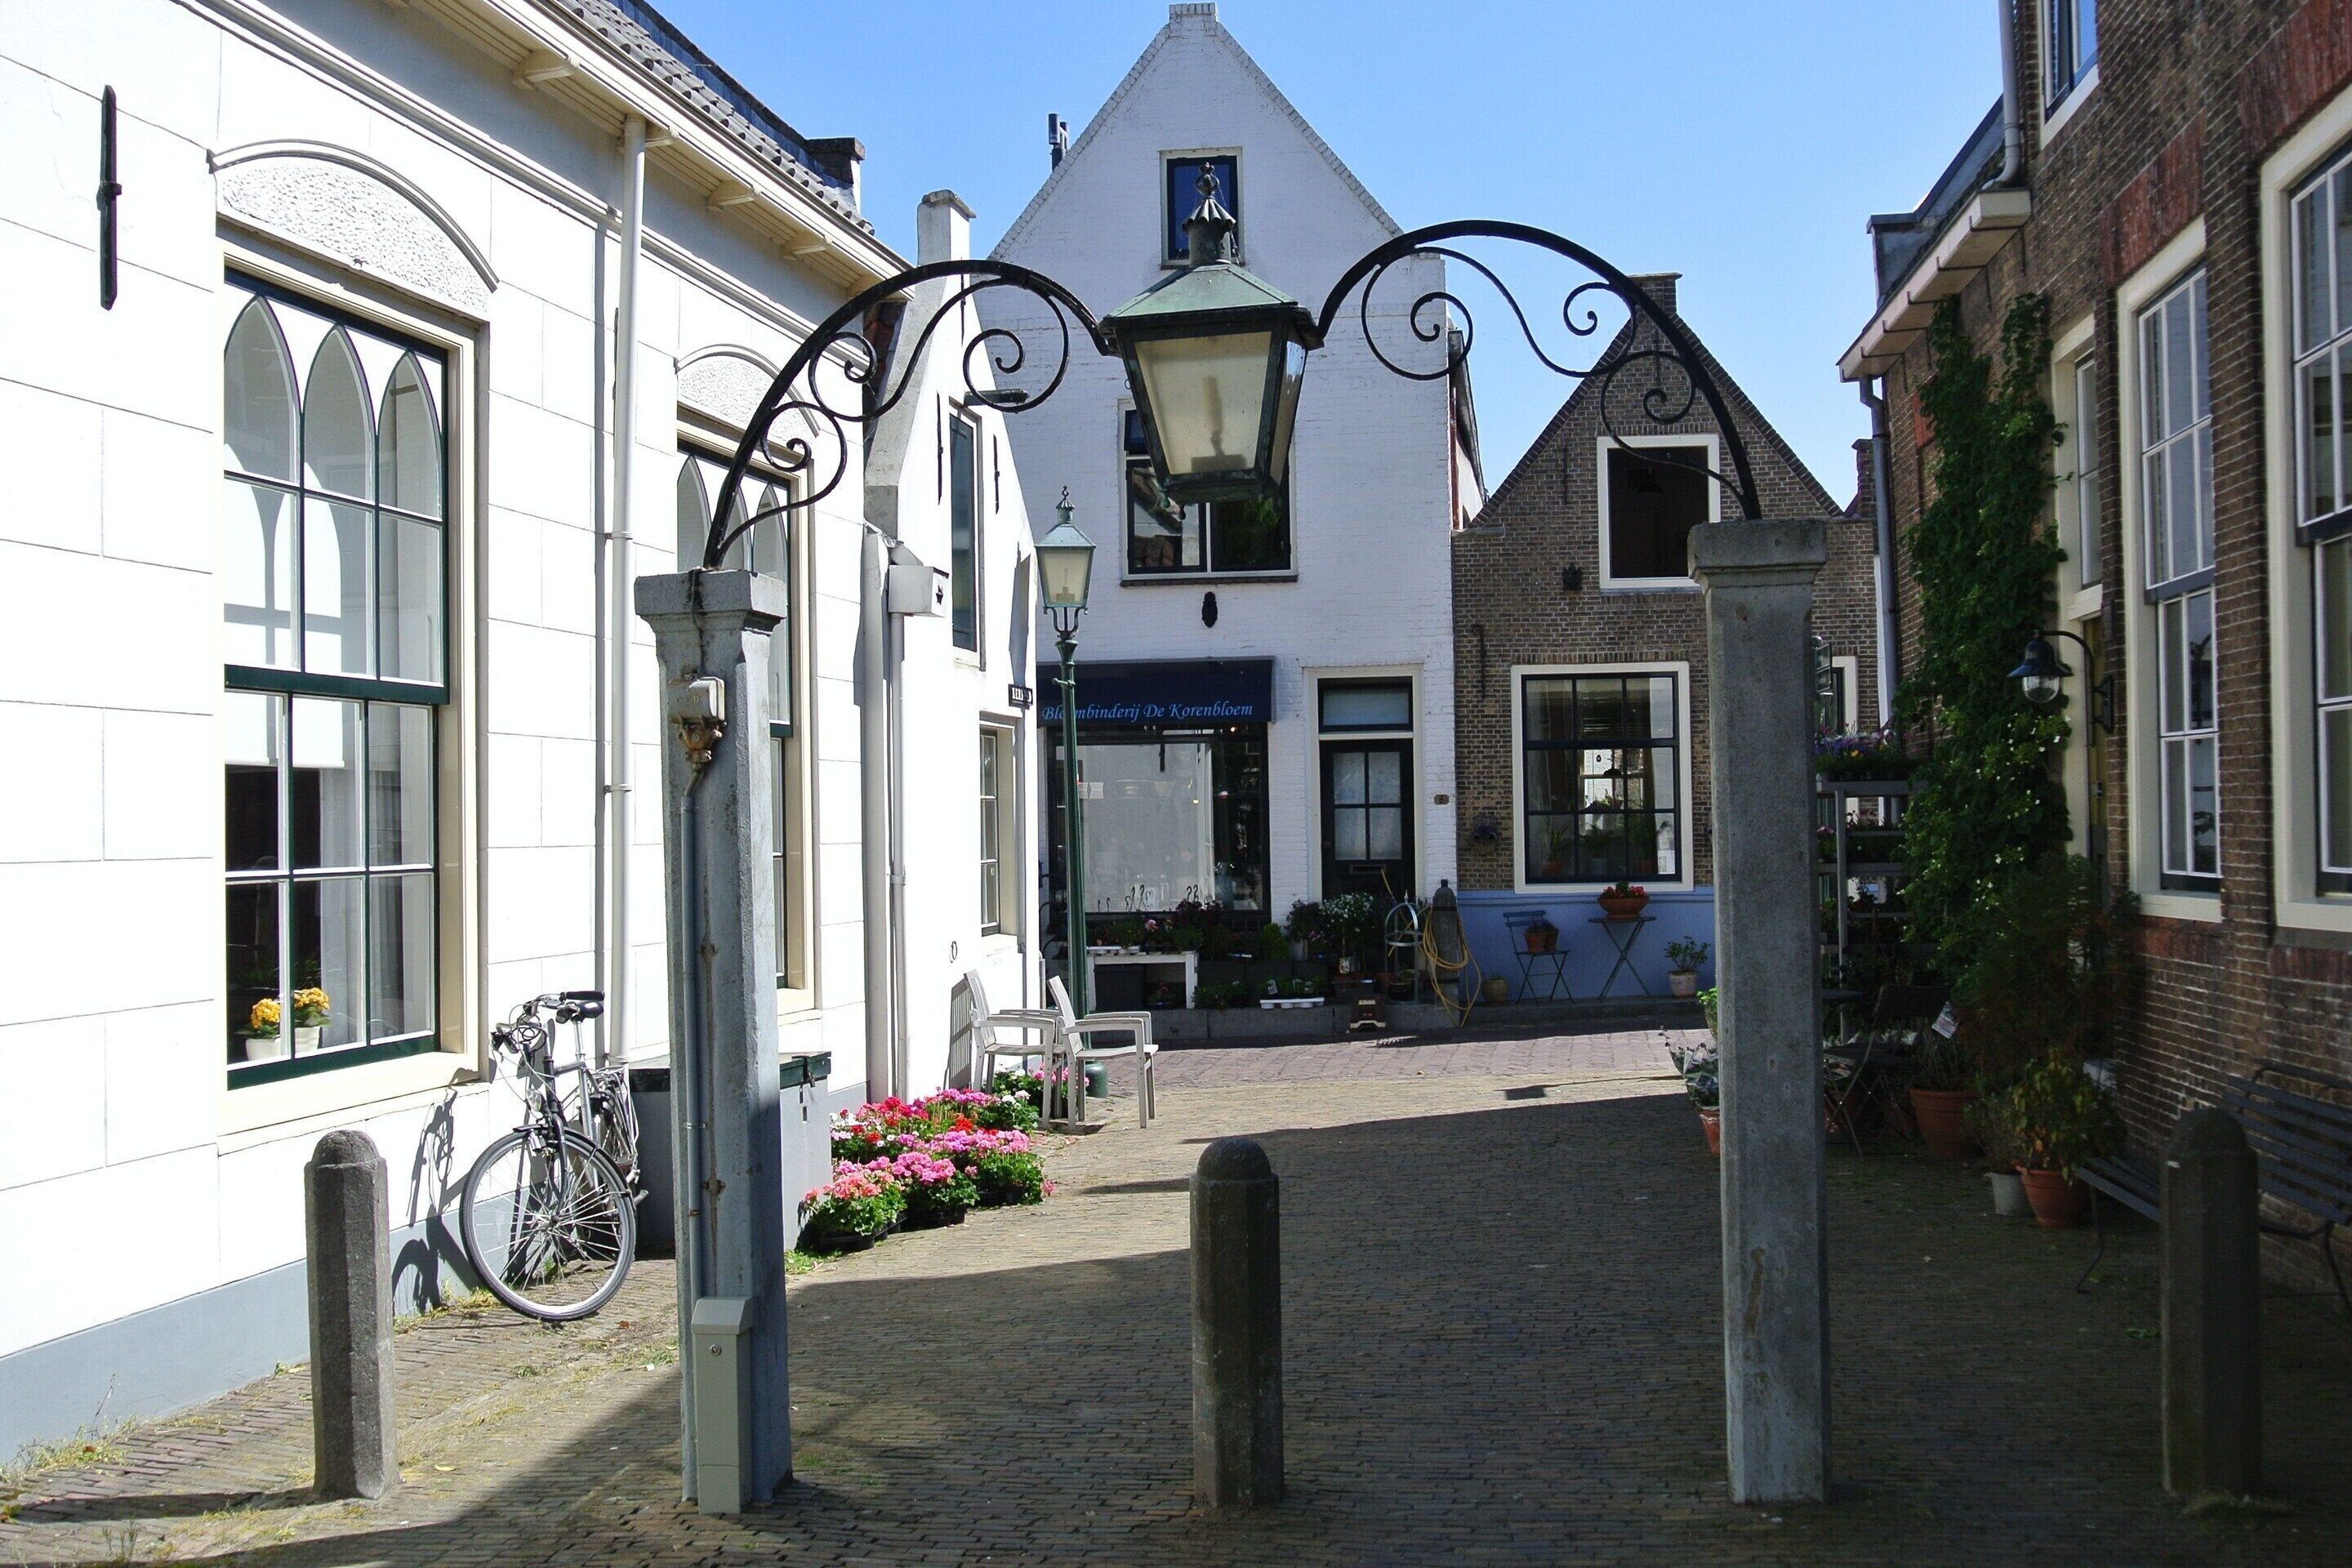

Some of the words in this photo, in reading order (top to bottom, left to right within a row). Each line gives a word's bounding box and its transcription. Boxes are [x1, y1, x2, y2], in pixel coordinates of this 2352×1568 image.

[1042, 703, 1141, 722] Blombinderij
[1143, 704, 1165, 718] De
[1169, 701, 1254, 719] Korenbloem
